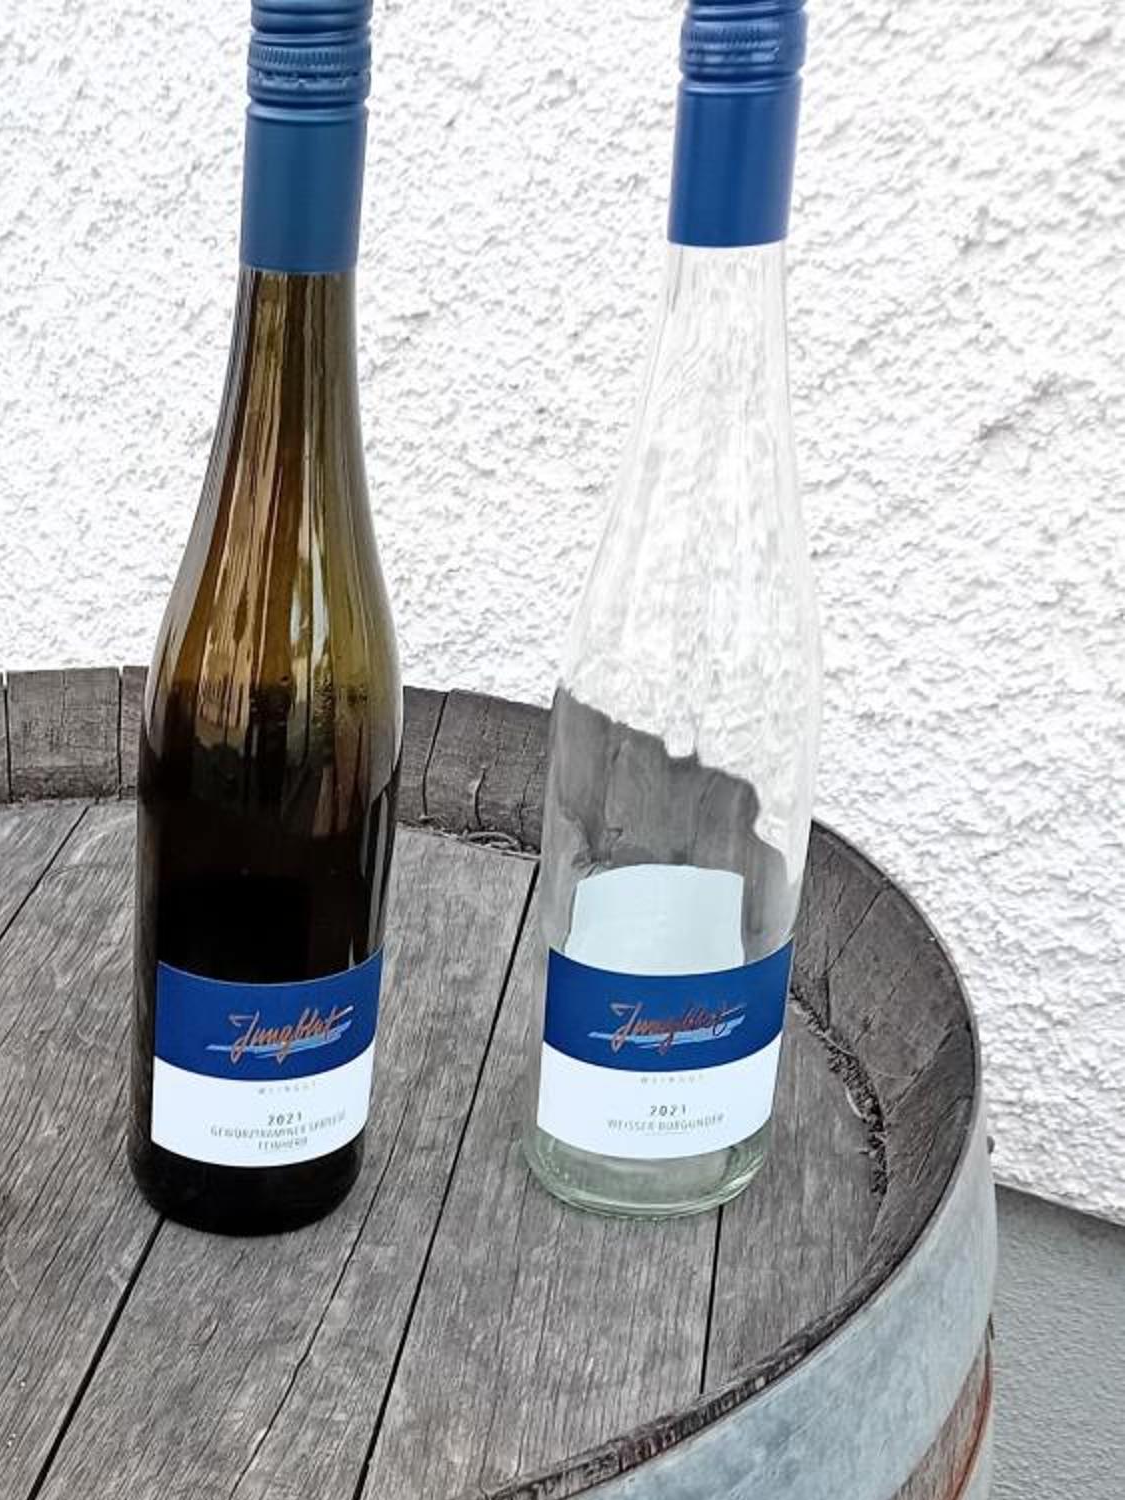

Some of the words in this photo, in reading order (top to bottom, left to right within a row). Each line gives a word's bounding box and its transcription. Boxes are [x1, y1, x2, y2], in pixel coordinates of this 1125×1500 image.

[229, 1004, 354, 1064] Jungblut
[650, 1104, 687, 1117] 2021
[267, 1111, 302, 1127] 2021
[607, 1119, 655, 1132] WEISSER
[658, 1113, 724, 1132] BURGUNDER
[258, 1137, 308, 1150] FEINHERB
